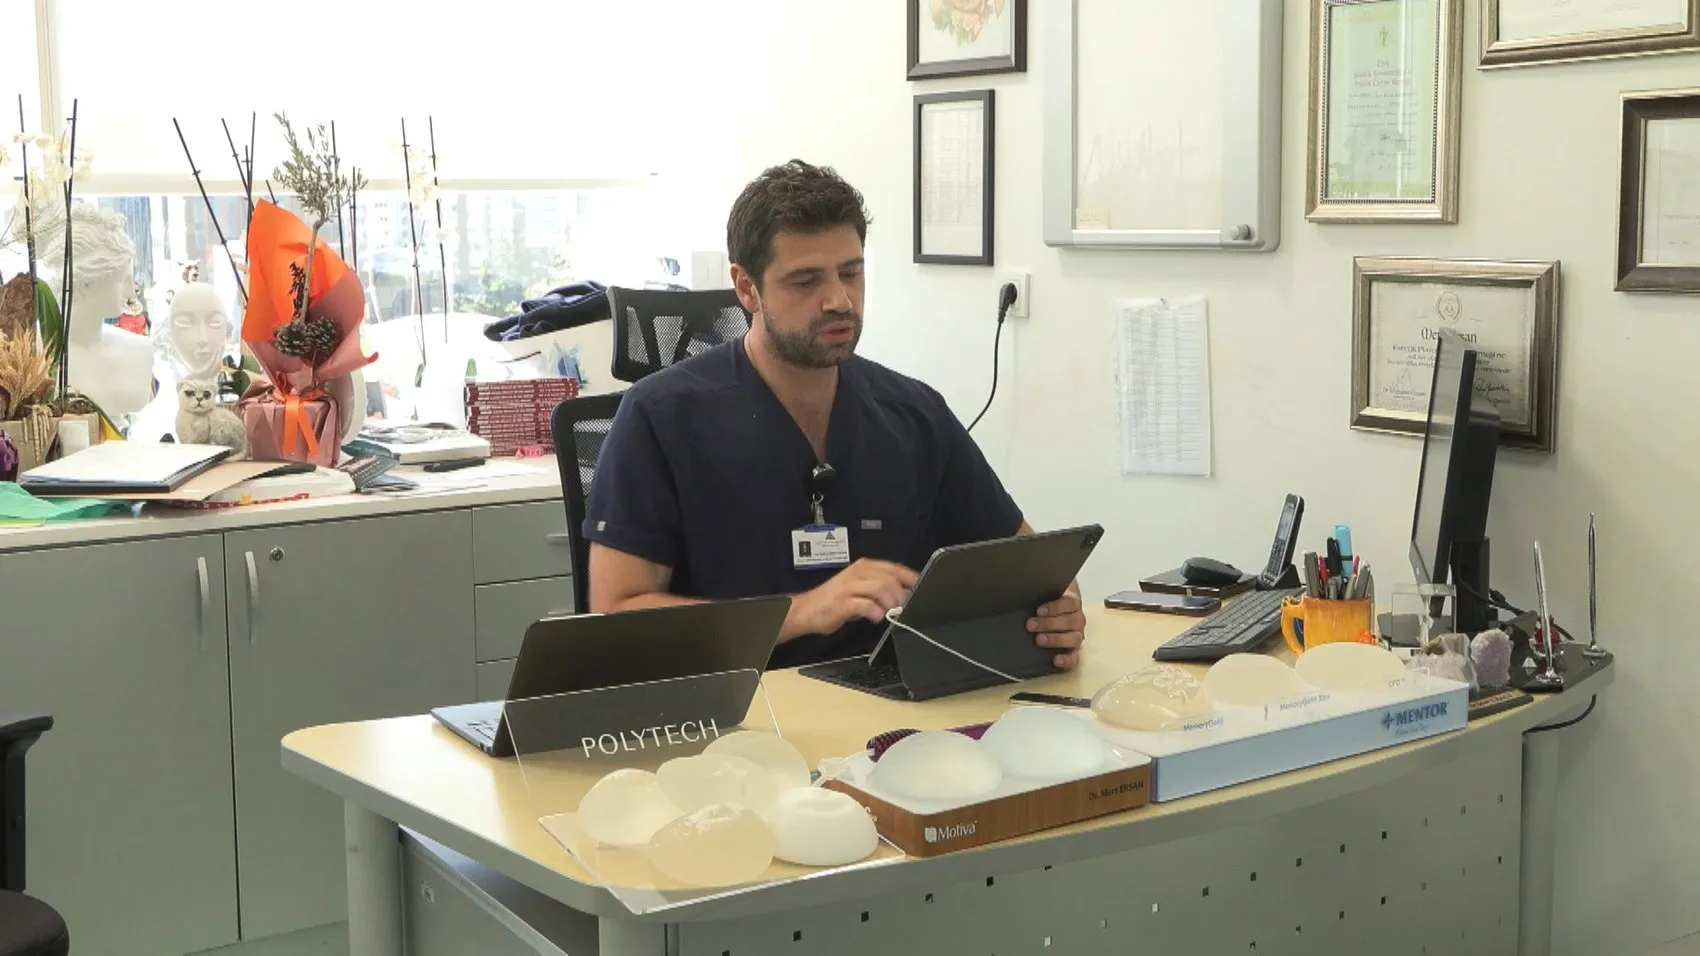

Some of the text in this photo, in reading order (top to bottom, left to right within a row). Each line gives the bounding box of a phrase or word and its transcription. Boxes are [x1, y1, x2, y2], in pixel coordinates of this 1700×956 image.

[1396, 702, 1448, 726] MENTOR
[581, 718, 719, 758] POLYTECH
[1088, 779, 1144, 801] Dr. Mert ERSAN
[936, 820, 977, 843] Motiva
